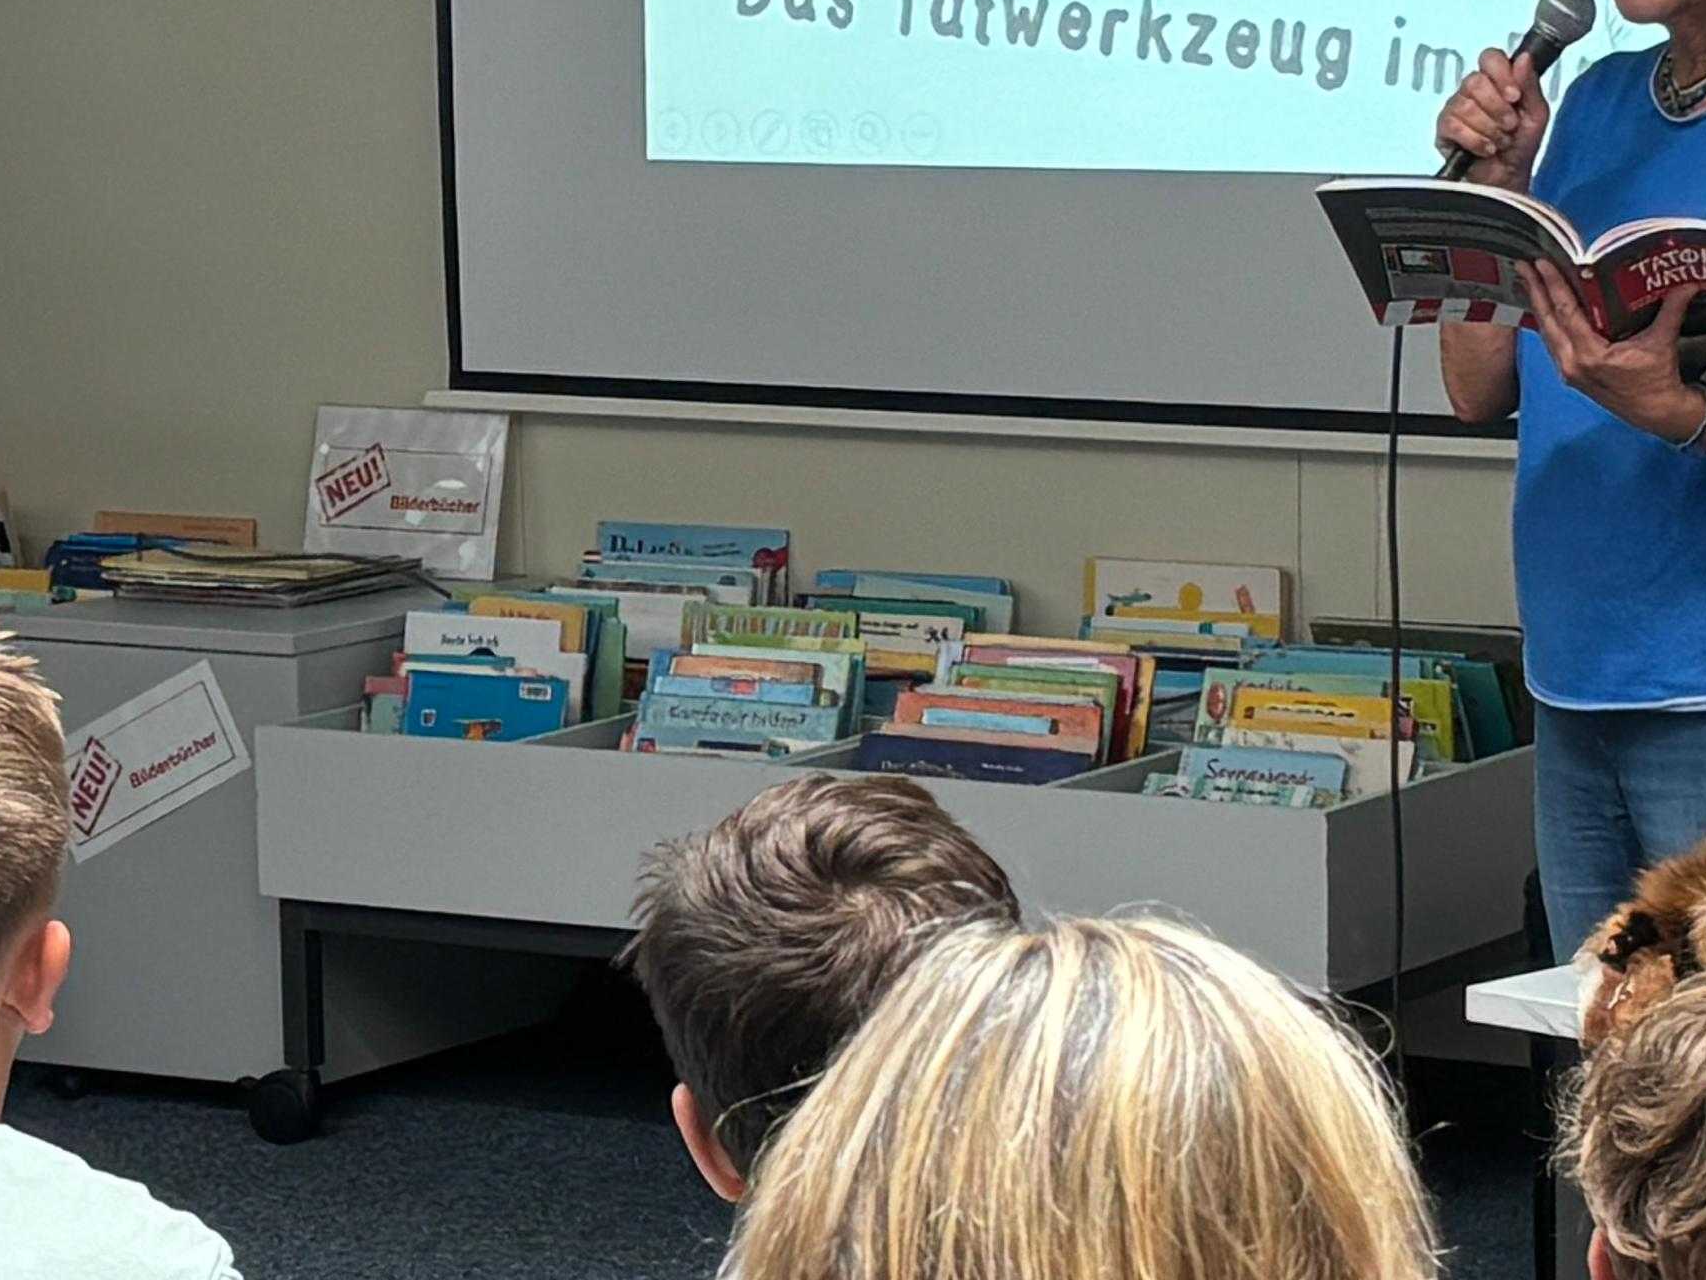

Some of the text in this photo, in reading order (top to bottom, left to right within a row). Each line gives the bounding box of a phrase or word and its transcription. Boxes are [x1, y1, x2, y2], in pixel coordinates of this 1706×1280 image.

[1384, 15, 1465, 95] im
[324, 458, 382, 508] NEU!
[390, 495, 481, 514] Bilderbücher
[71, 751, 112, 820] NEU!
[128, 731, 217, 789] Bilderbücher
